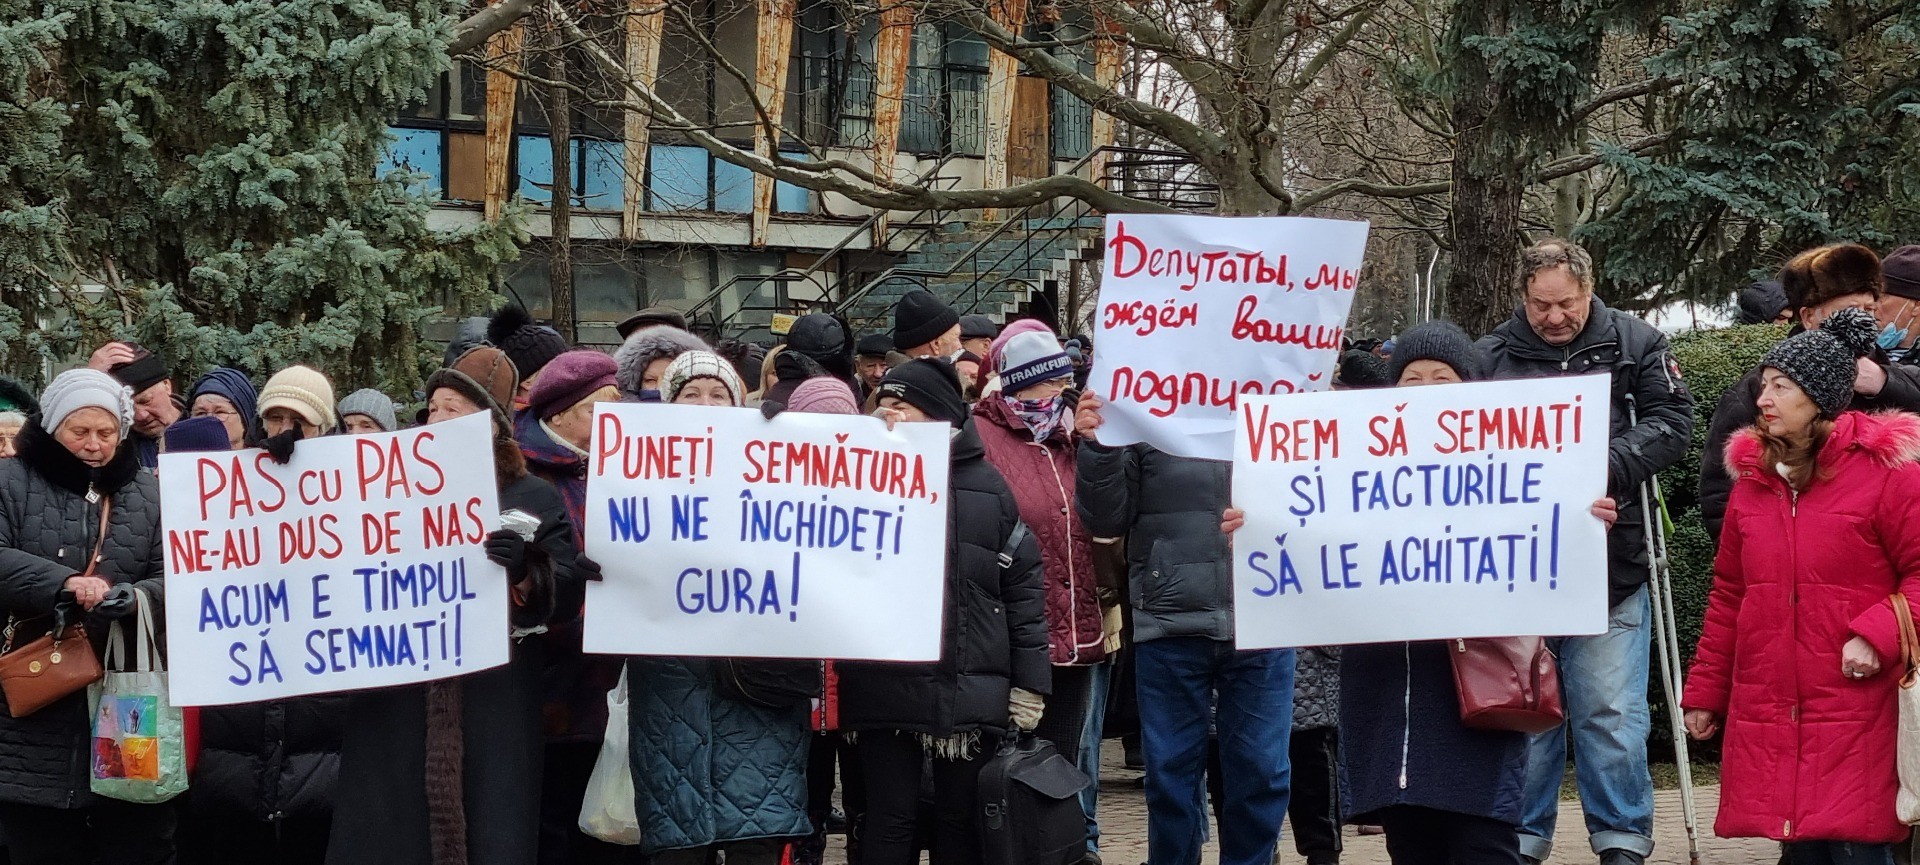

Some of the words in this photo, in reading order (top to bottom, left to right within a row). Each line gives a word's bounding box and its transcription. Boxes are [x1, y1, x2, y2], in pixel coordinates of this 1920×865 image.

[1109, 220, 1295, 292] Депутаты,
[1304, 264, 1359, 291] мы
[1104, 299, 1198, 336] ждём
[1109, 366, 1323, 418] подпи
[1243, 402, 1340, 463] VREM
[1367, 401, 1409, 457] SĂ
[197, 451, 287, 521] PAS
[355, 431, 446, 502] PAS
[743, 433, 939, 505] SEMNĂTURA,
[1351, 452, 1545, 513] FACTURILE
[168, 525, 263, 574] NE-AU
[279, 512, 344, 565] DUS
[361, 510, 402, 556] DE
[607, 495, 651, 544] NU
[671, 495, 710, 543] NE
[198, 578, 290, 634] ACUM
[312, 573, 332, 620] E
[352, 557, 477, 613] TIMPUL
[675, 551, 802, 622] GURA!
[1248, 531, 1304, 597] SĂ
[1319, 541, 1361, 591] LE
[227, 627, 284, 687] SĂ
